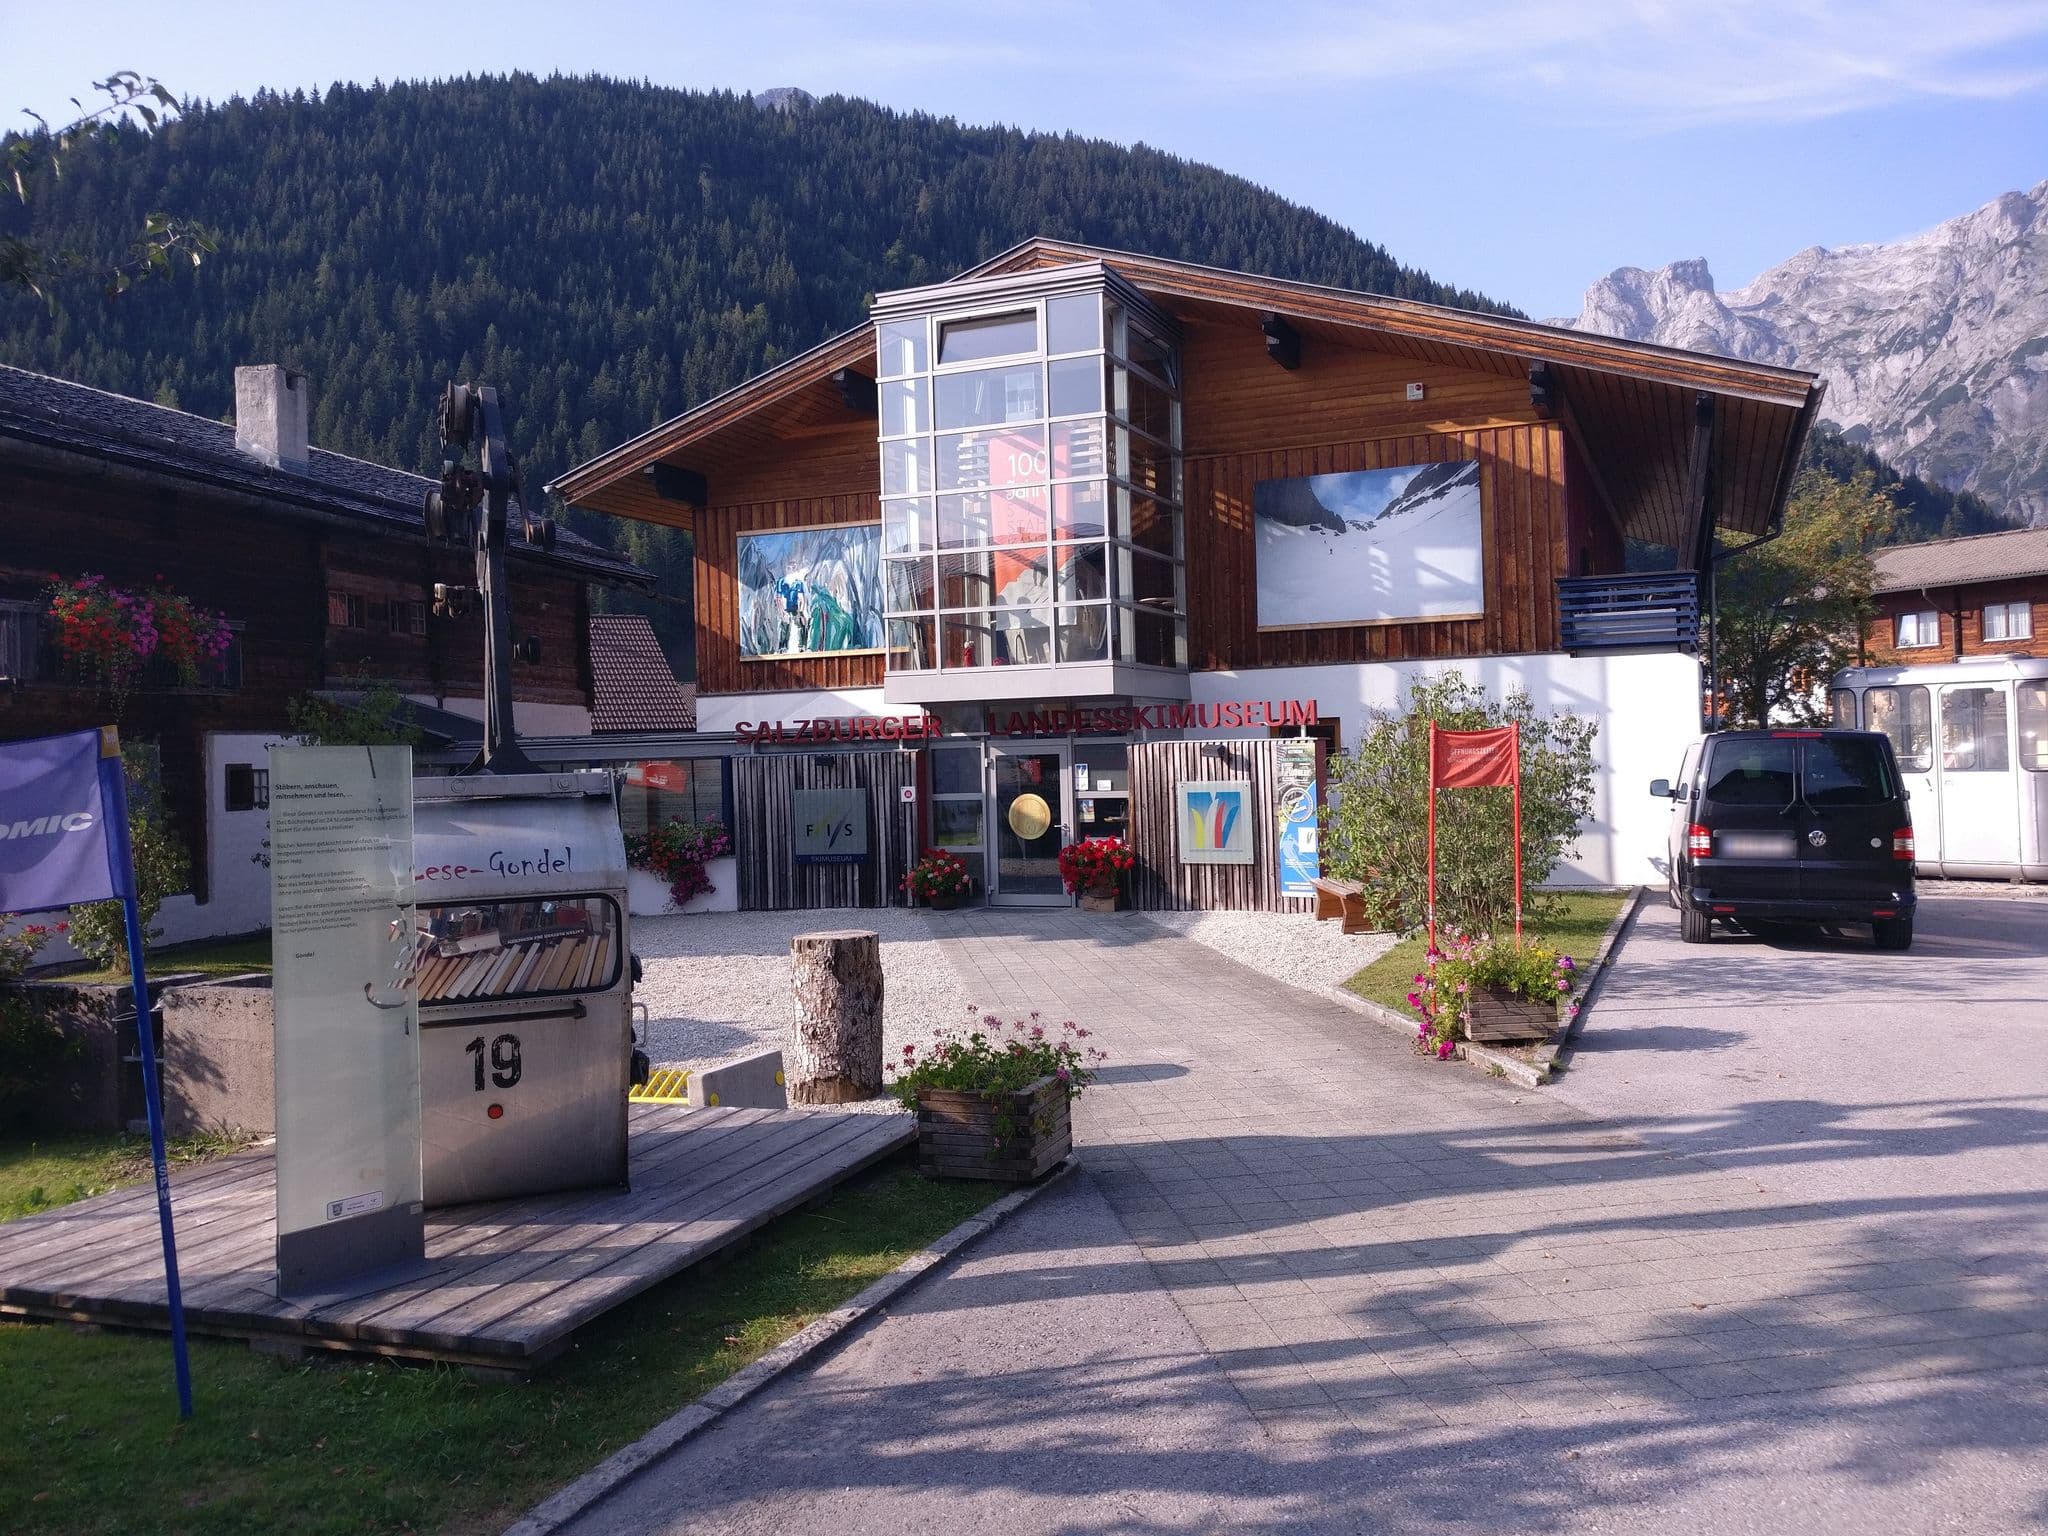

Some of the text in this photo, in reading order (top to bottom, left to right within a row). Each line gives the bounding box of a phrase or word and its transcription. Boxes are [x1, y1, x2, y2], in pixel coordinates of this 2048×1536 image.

[1007, 450, 1047, 477] 100
[735, 699, 1318, 745] SALZBURGER LANDESSKIMUSEUM
[0, 812, 93, 840] MIC
[465, 1033, 522, 1092] 19
